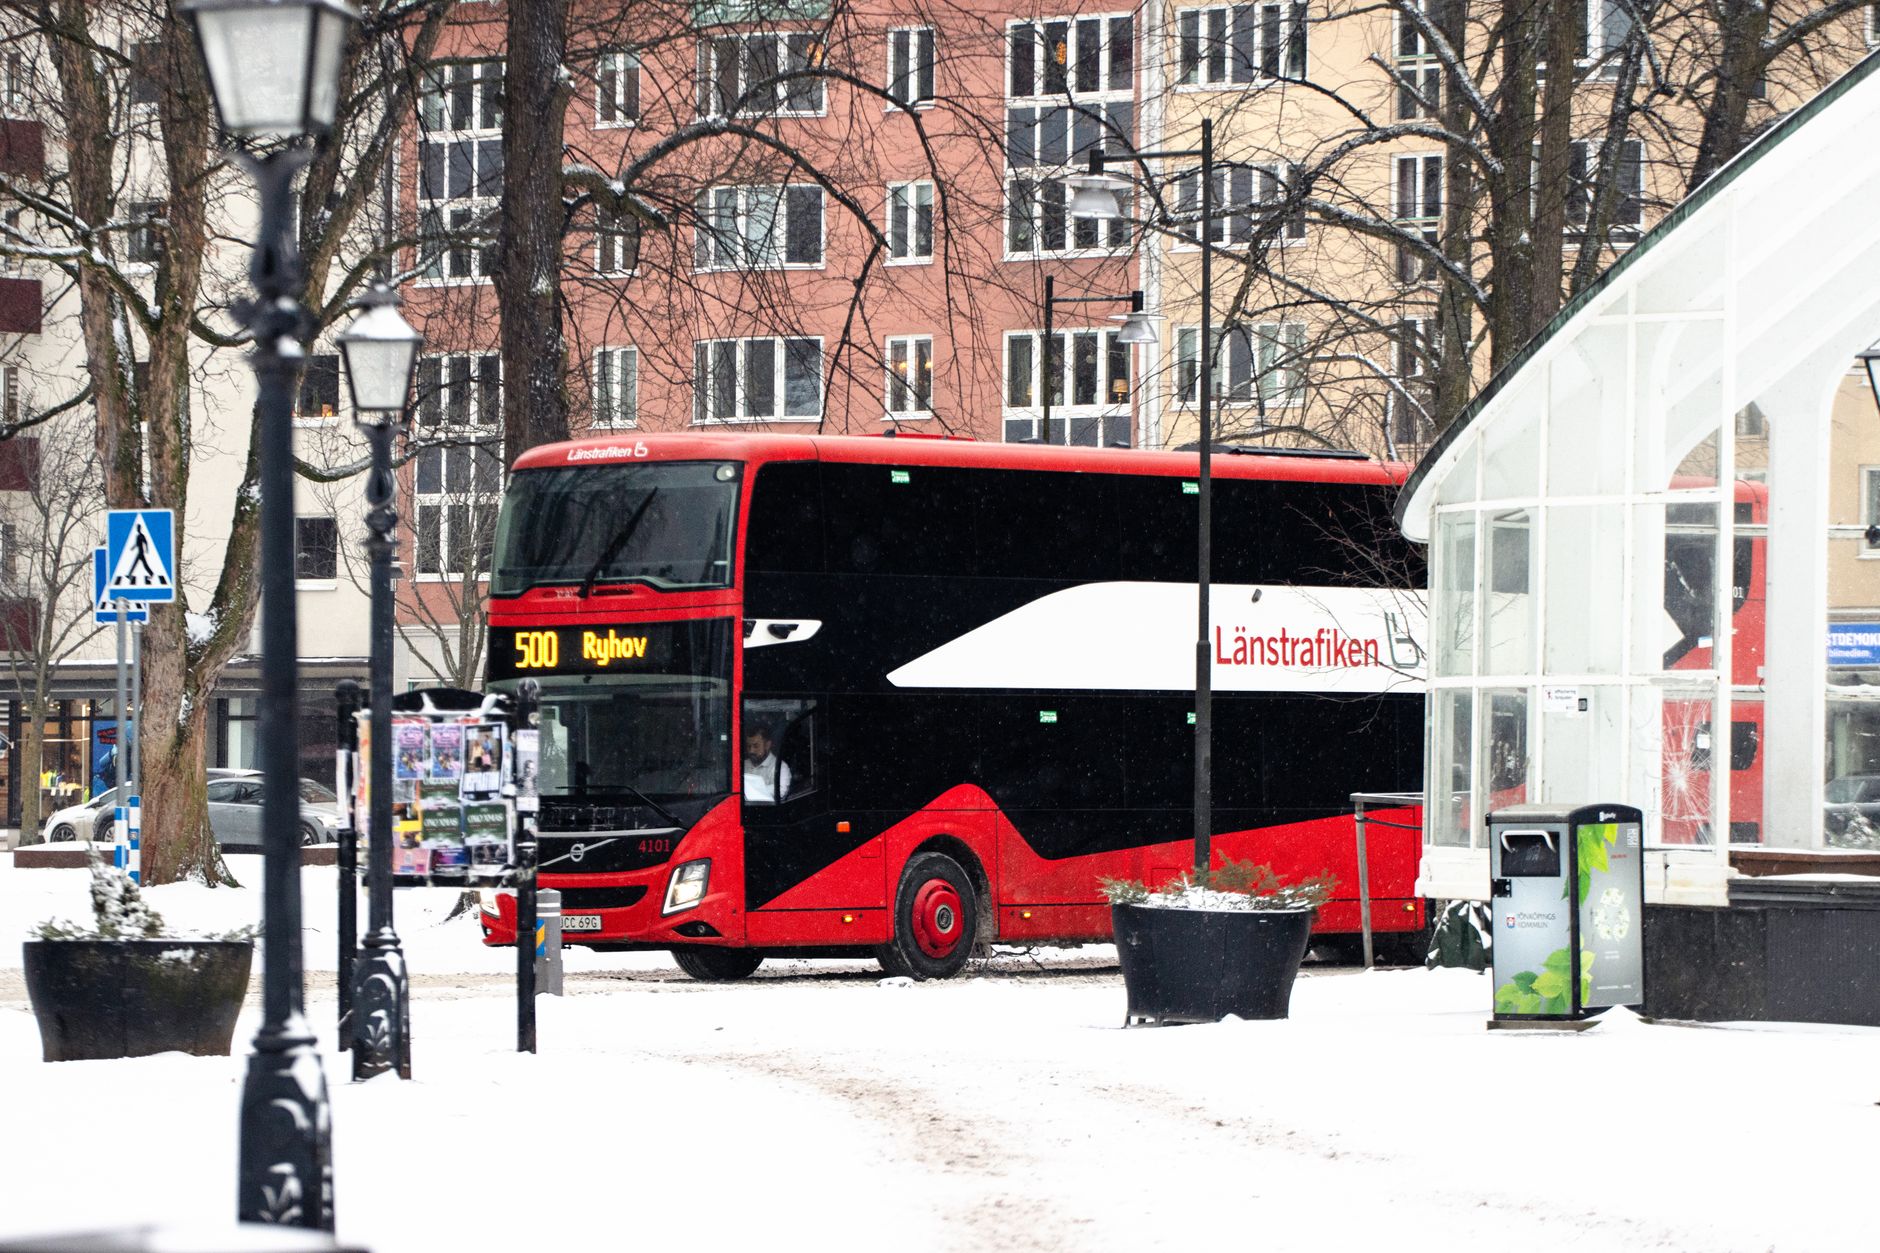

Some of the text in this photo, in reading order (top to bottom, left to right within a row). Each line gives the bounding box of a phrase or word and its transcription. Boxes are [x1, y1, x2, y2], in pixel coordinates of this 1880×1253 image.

[567, 446, 632, 461] Länstrafiken
[1216, 625, 1379, 667] Länstrafiken
[1826, 632, 1880, 646] STDEMOK
[515, 629, 647, 668] 500 Ryhov
[638, 839, 670, 853] 4101
[578, 917, 597, 928] 69G
